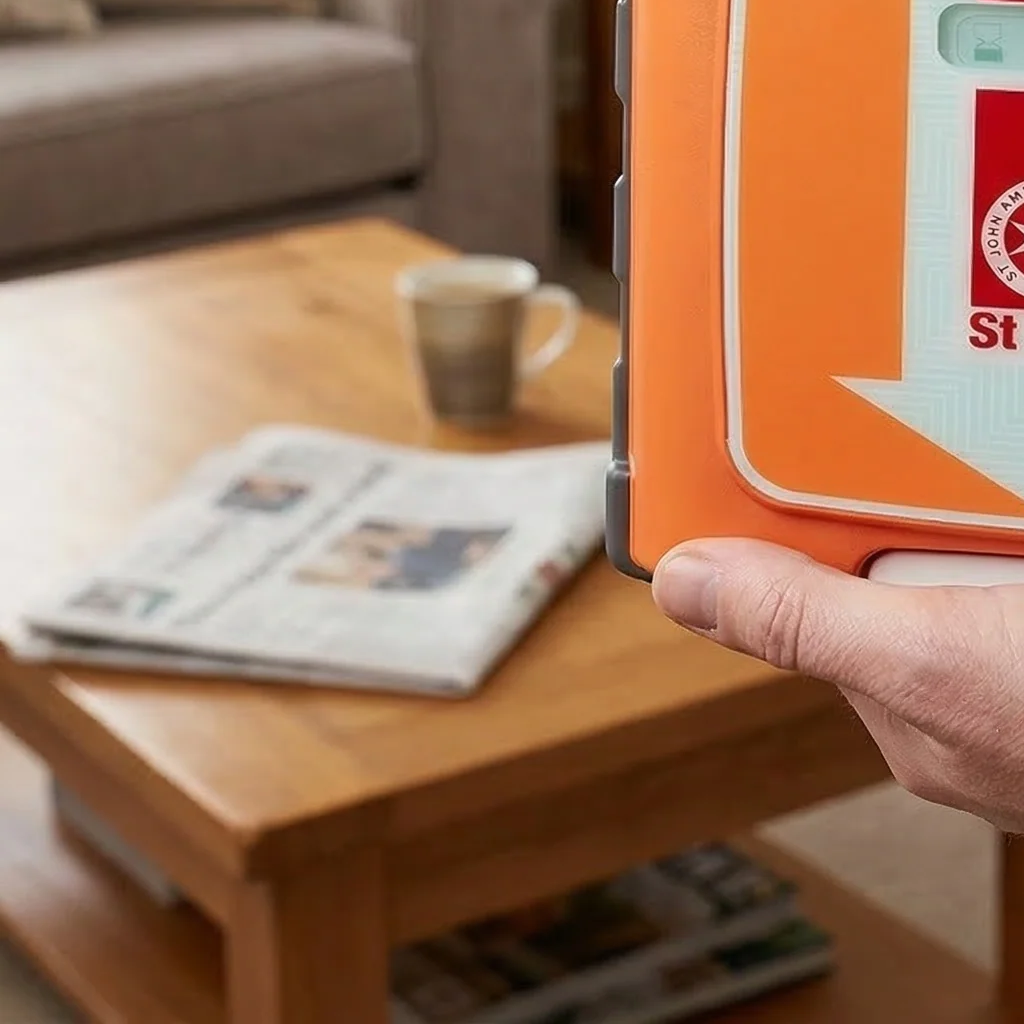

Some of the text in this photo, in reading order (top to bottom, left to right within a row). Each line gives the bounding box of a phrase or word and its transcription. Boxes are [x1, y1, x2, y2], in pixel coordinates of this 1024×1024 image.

[987, 215, 1002, 256] JOHN
[998, 265, 1017, 282] ST
[968, 312, 1017, 350] St
